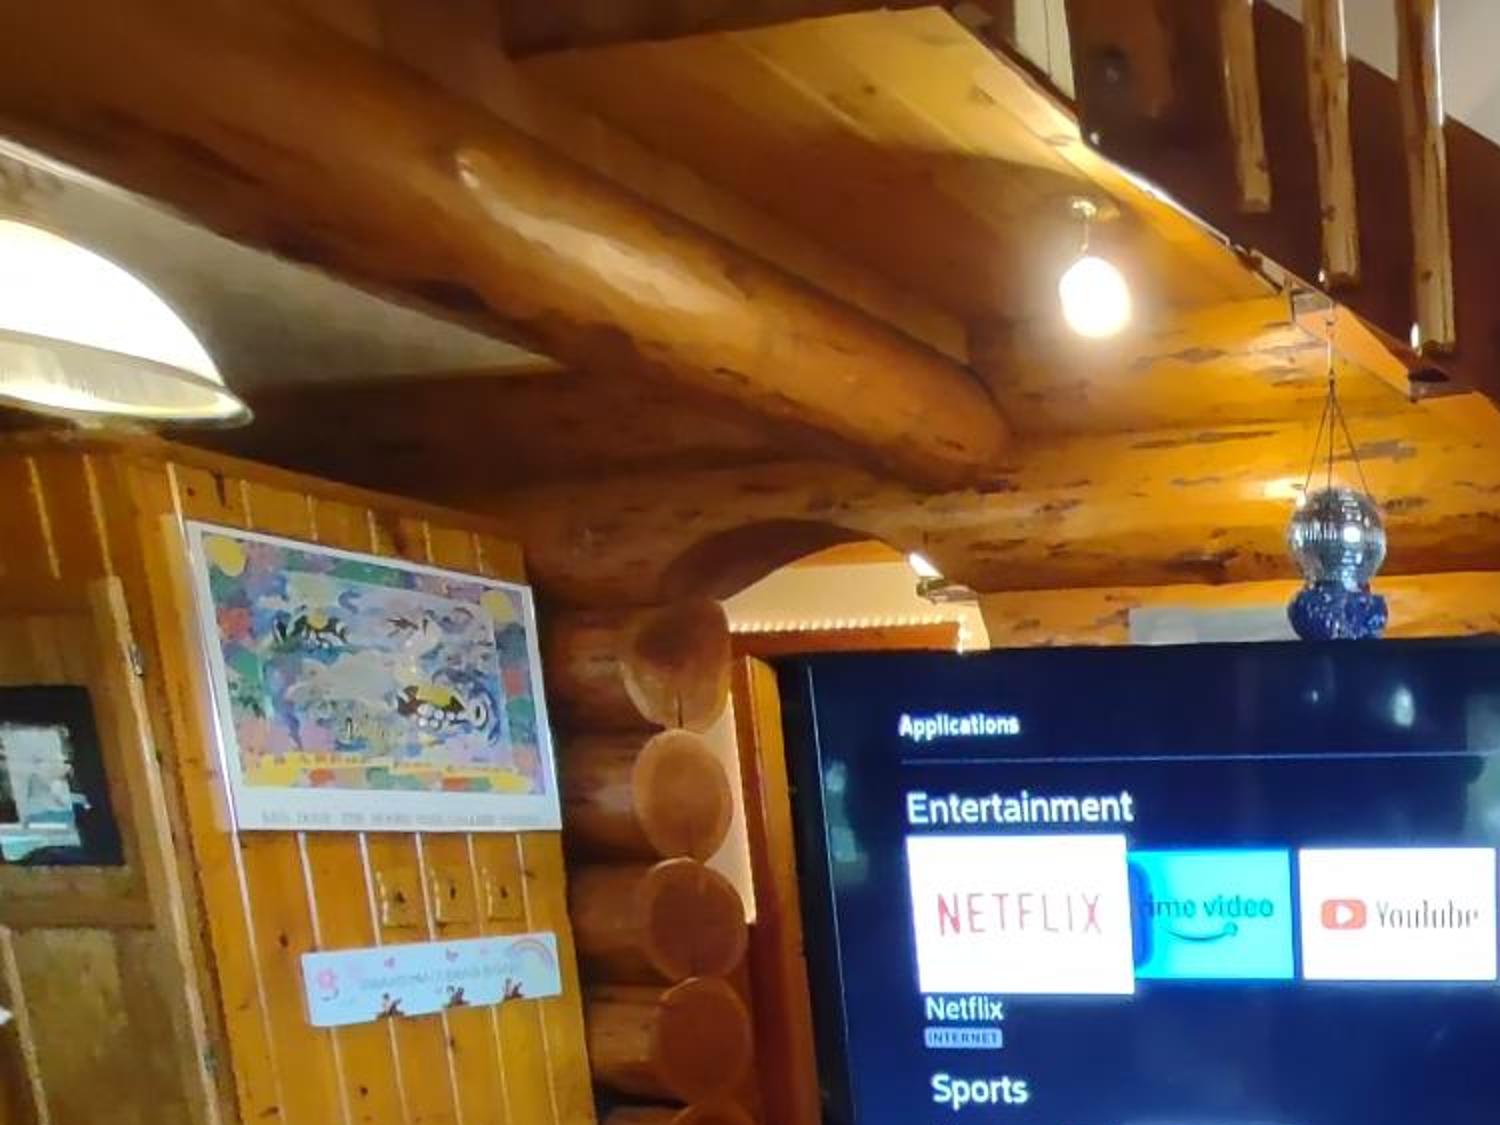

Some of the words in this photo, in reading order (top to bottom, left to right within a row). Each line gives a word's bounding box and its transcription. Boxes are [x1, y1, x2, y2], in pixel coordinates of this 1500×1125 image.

[898, 713, 1020, 741] Applications
[906, 790, 1134, 825] Entertainment
[937, 893, 1101, 936] NETFLIX
[1203, 894, 1275, 918] video
[926, 995, 1004, 1021] Netflix
[928, 1031, 998, 1044] INTERNET
[931, 1073, 1029, 1110] Sports
